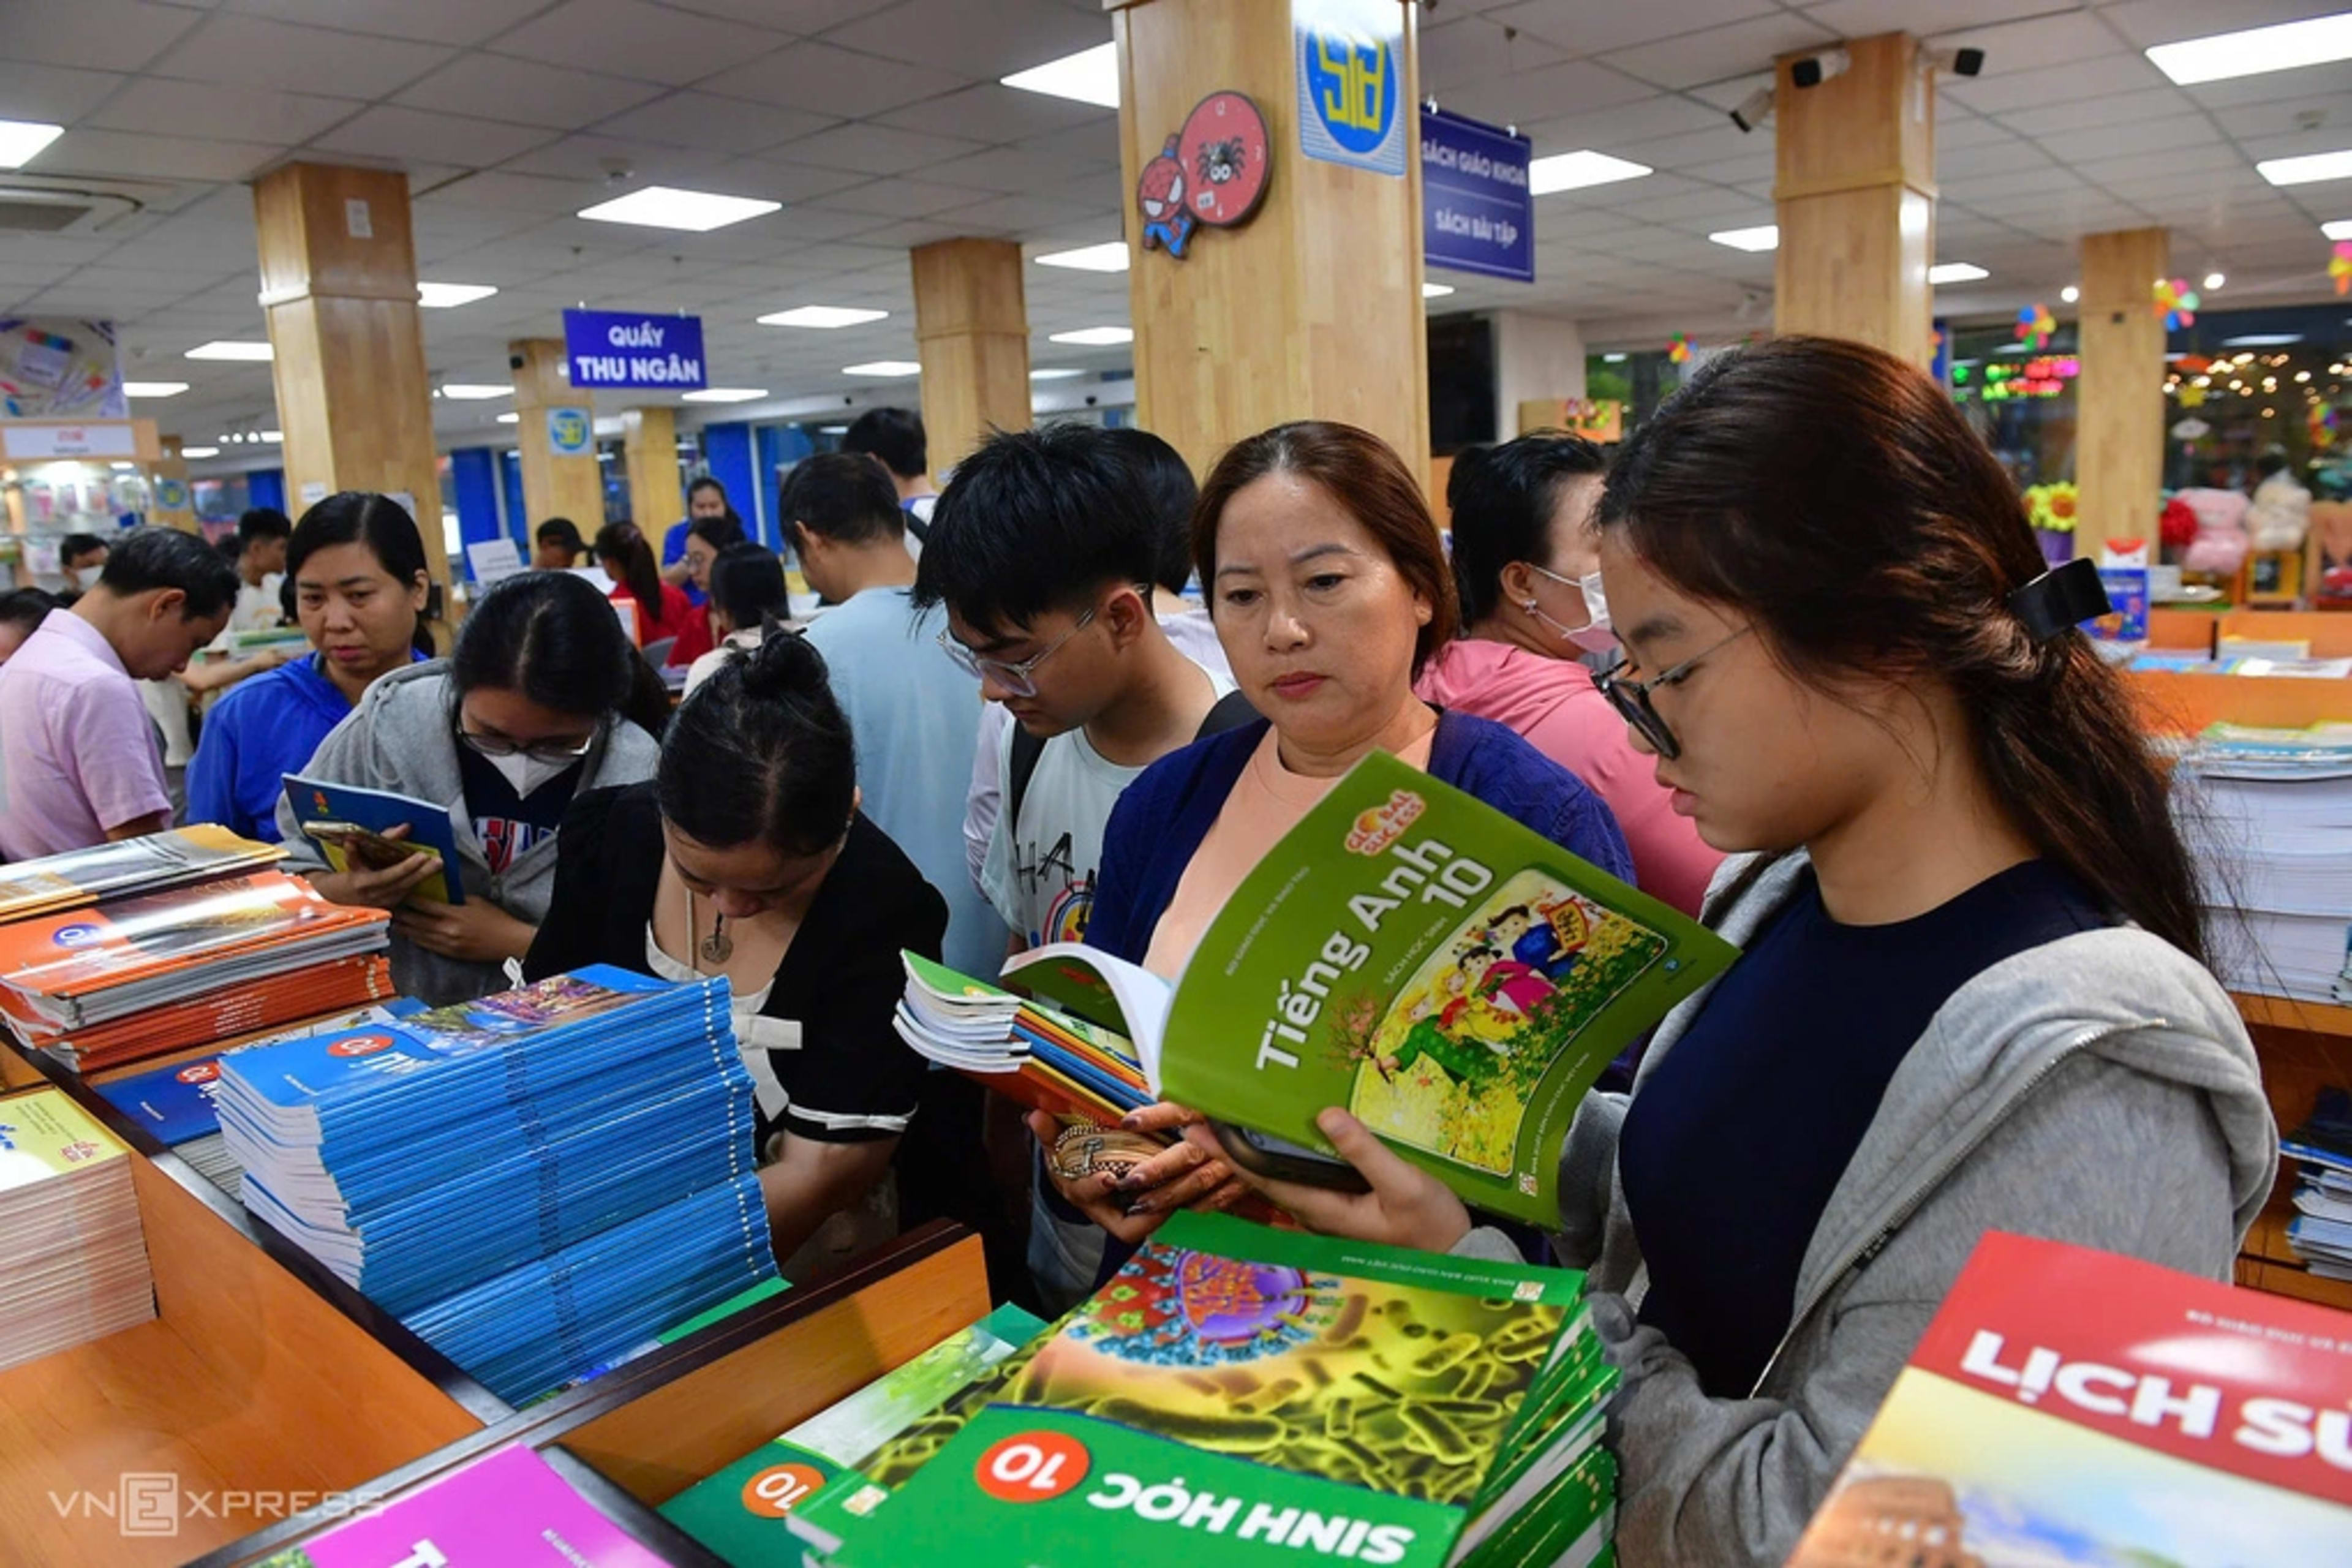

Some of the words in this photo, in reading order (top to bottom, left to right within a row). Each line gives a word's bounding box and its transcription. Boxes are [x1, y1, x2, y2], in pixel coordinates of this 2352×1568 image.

[1436, 207, 1470, 236] SÁCH
[576, 356, 626, 381] THU
[630, 352, 699, 382] NGÂN
[1421, 858, 1494, 908] 10
[1255, 930, 1371, 1070] Tiếng
[1348, 839, 1454, 932] Anh
[1961, 1329, 2222, 1439] LỊCH
[755, 1471, 810, 1511] 10
[990, 1444, 1067, 1489] 10
[1085, 1473, 1243, 1532] HỌC
[1236, 1502, 1416, 1564] SINH
